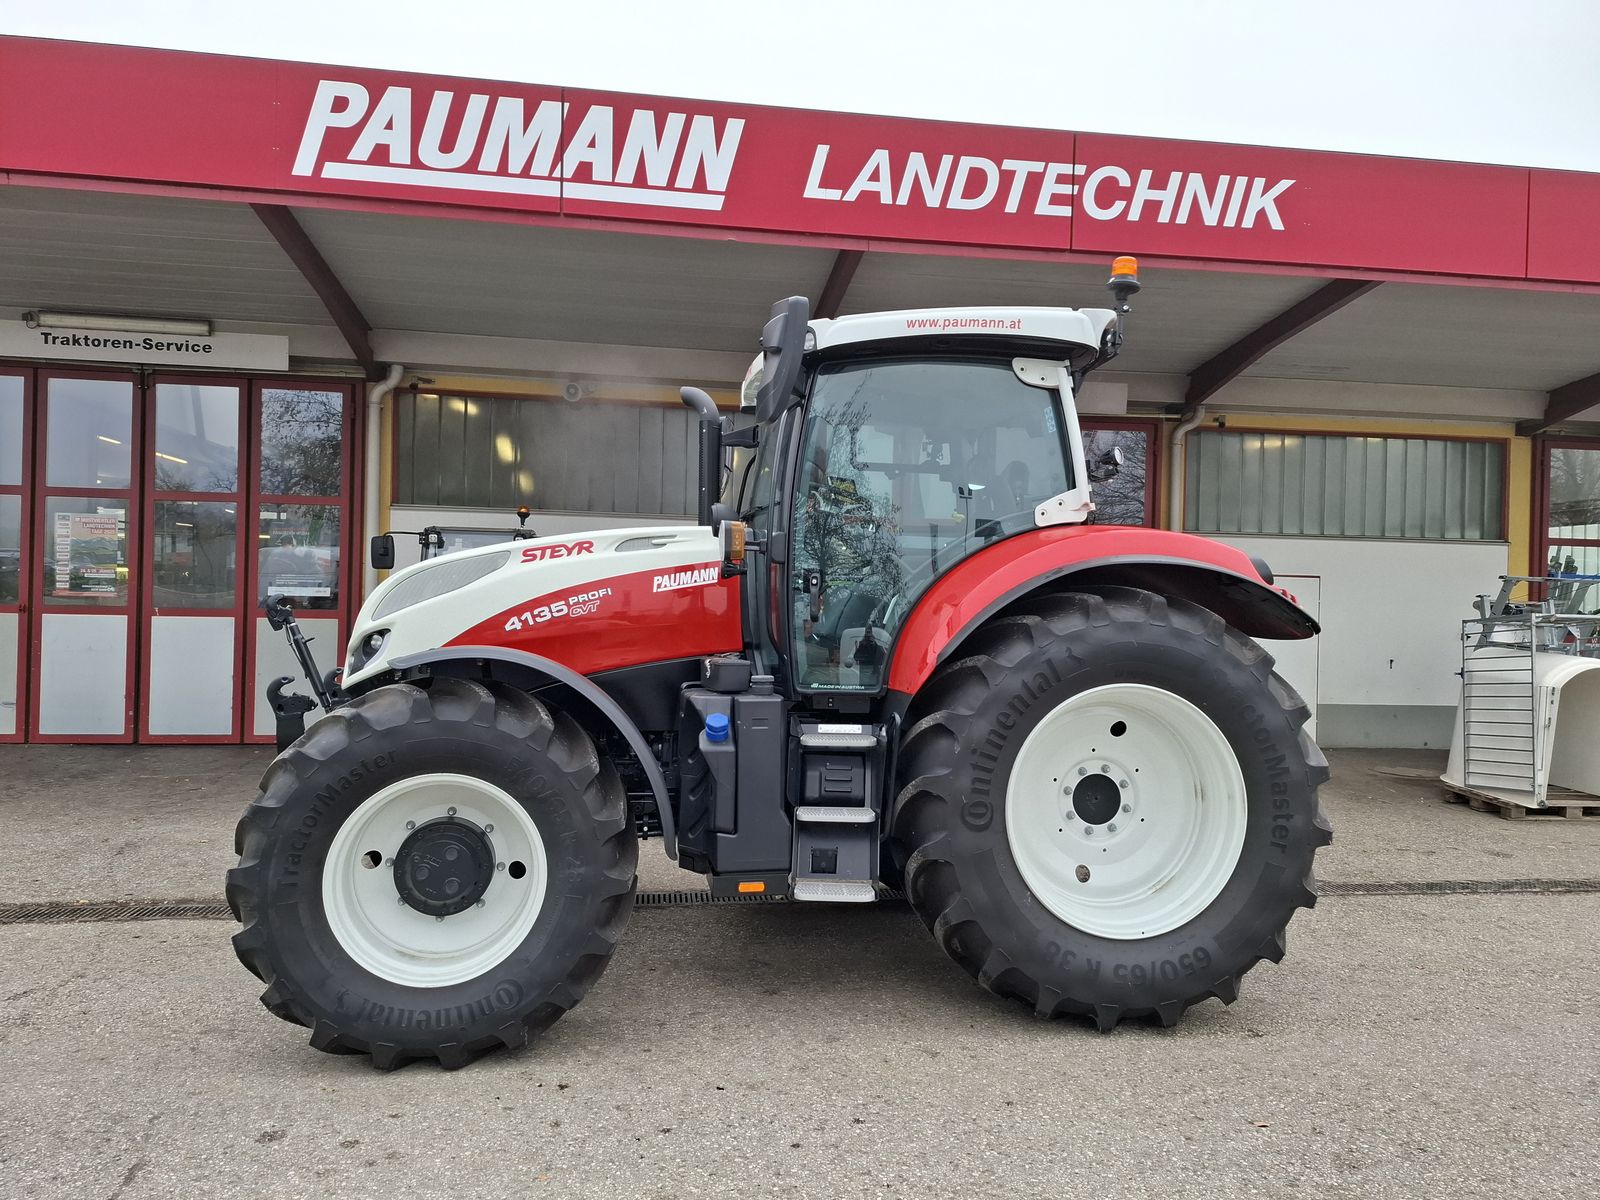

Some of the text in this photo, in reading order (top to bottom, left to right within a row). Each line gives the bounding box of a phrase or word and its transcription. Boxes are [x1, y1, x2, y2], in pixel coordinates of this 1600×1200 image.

[292, 79, 1296, 231] PAUMANN LANDTECHNIK
[906, 318, 1022, 330] www.paumann.at
[41, 332, 213, 354] Traktoren-Service
[520, 540, 594, 564] STEYR
[652, 567, 719, 593] PAUMANN
[568, 587, 612, 606] PROFI
[569, 600, 600, 618] CVT
[504, 601, 569, 632] 4135
[961, 658, 1065, 833] Continental
[280, 747, 398, 888] TractorMaster
